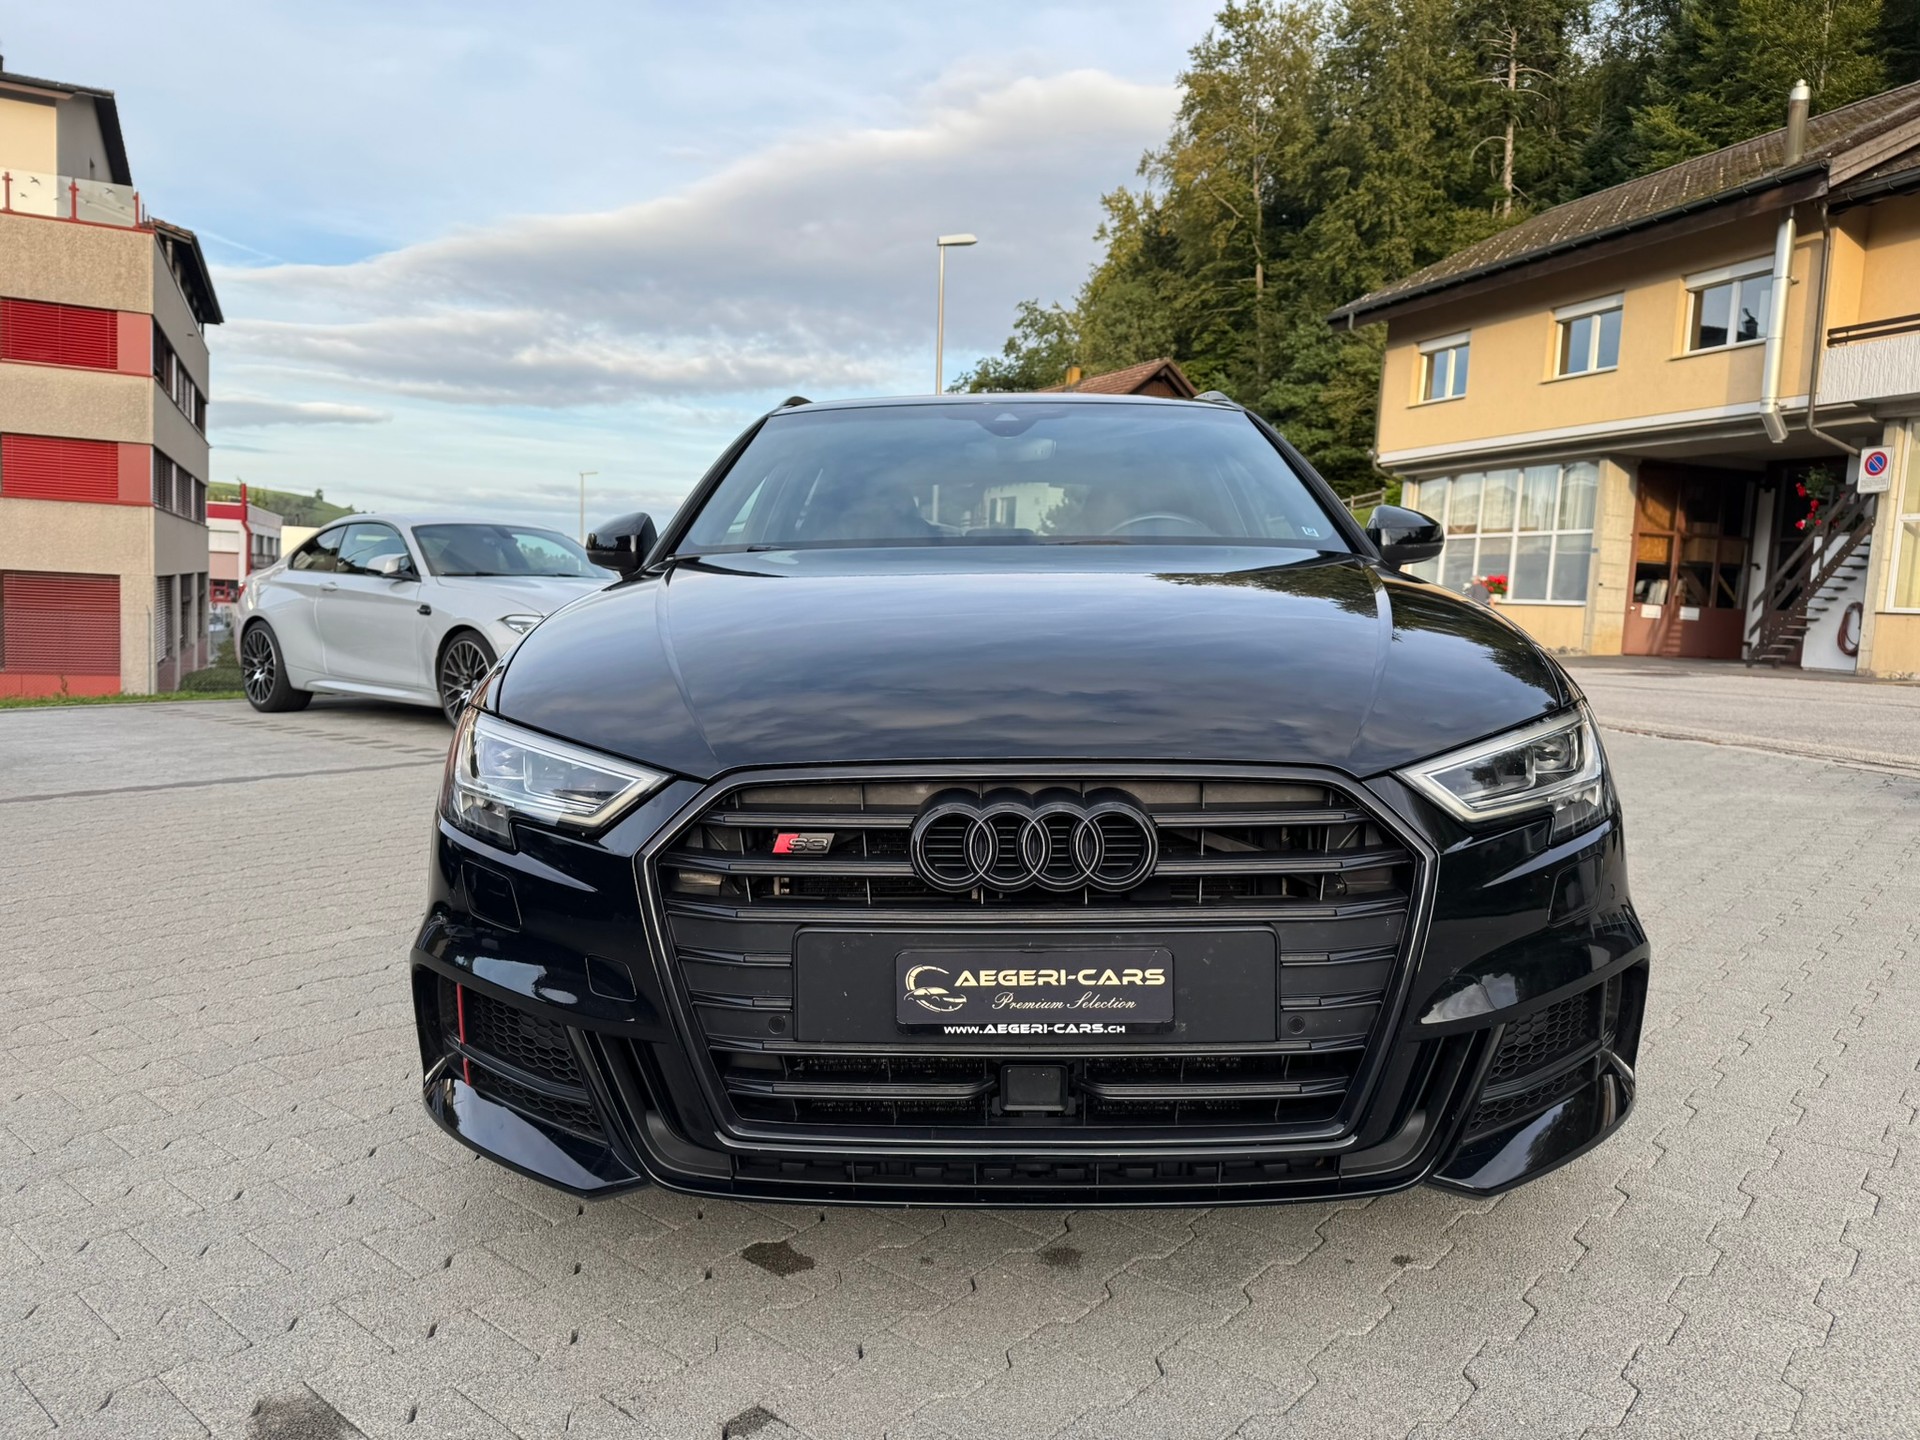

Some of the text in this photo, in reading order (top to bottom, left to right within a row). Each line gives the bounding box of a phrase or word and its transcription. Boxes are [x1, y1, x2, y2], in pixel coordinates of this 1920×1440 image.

[787, 837, 828, 851] S3
[954, 968, 1166, 987] AEGERI-CARS
[992, 991, 1137, 1010] Premium Selection
